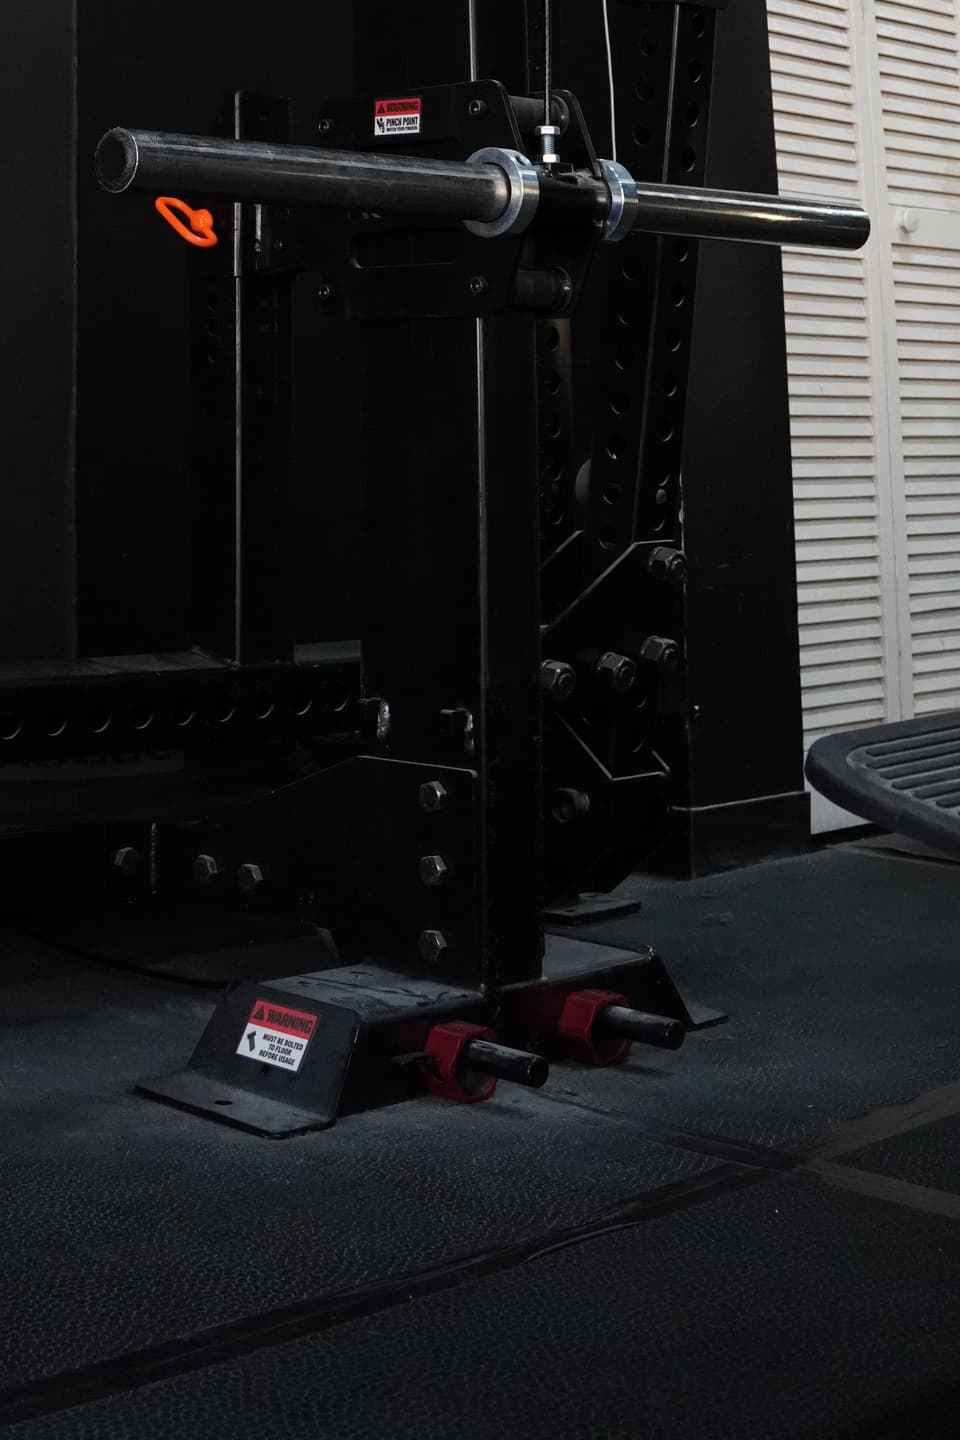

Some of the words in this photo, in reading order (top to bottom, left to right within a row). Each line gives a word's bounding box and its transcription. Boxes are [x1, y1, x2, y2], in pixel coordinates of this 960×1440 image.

[386, 101, 419, 113] WARNING
[267, 1009, 312, 1033] WARNING
[263, 1034, 277, 1042] MUST
[284, 1040, 303, 1050] BOLTED
[259, 1050, 277, 1060] BEFORE
[279, 1056, 295, 1065] USAGE
[276, 1046, 292, 1056] FLOOR
